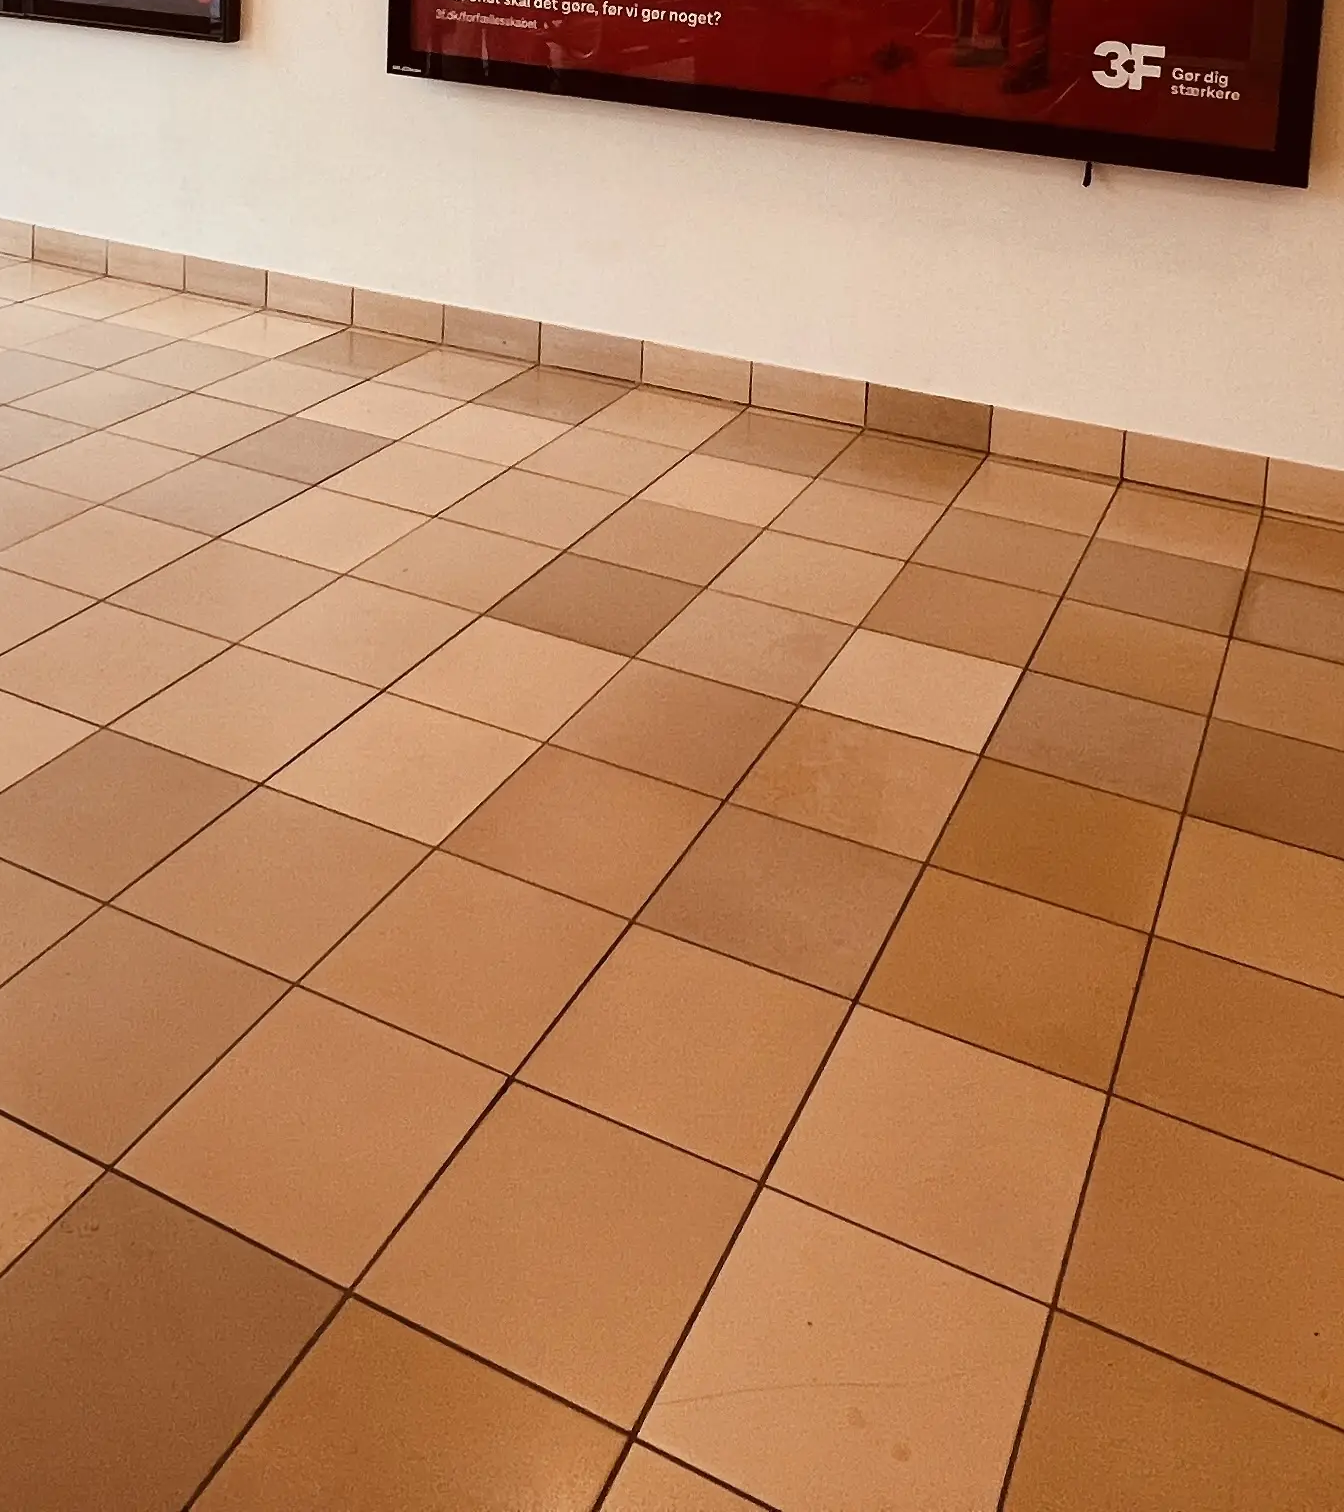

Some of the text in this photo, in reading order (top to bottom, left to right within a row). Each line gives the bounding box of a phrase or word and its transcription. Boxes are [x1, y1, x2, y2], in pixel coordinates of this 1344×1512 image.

[561, 0, 599, 16] gøre,
[602, 0, 624, 17] før
[626, 3, 638, 18] vi
[641, 7, 667, 22] gør
[669, 9, 722, 28] noget?
[1091, 40, 1166, 91] 3F
[1171, 67, 1229, 88] Gør dig
[1170, 83, 1241, 101] stærkere
